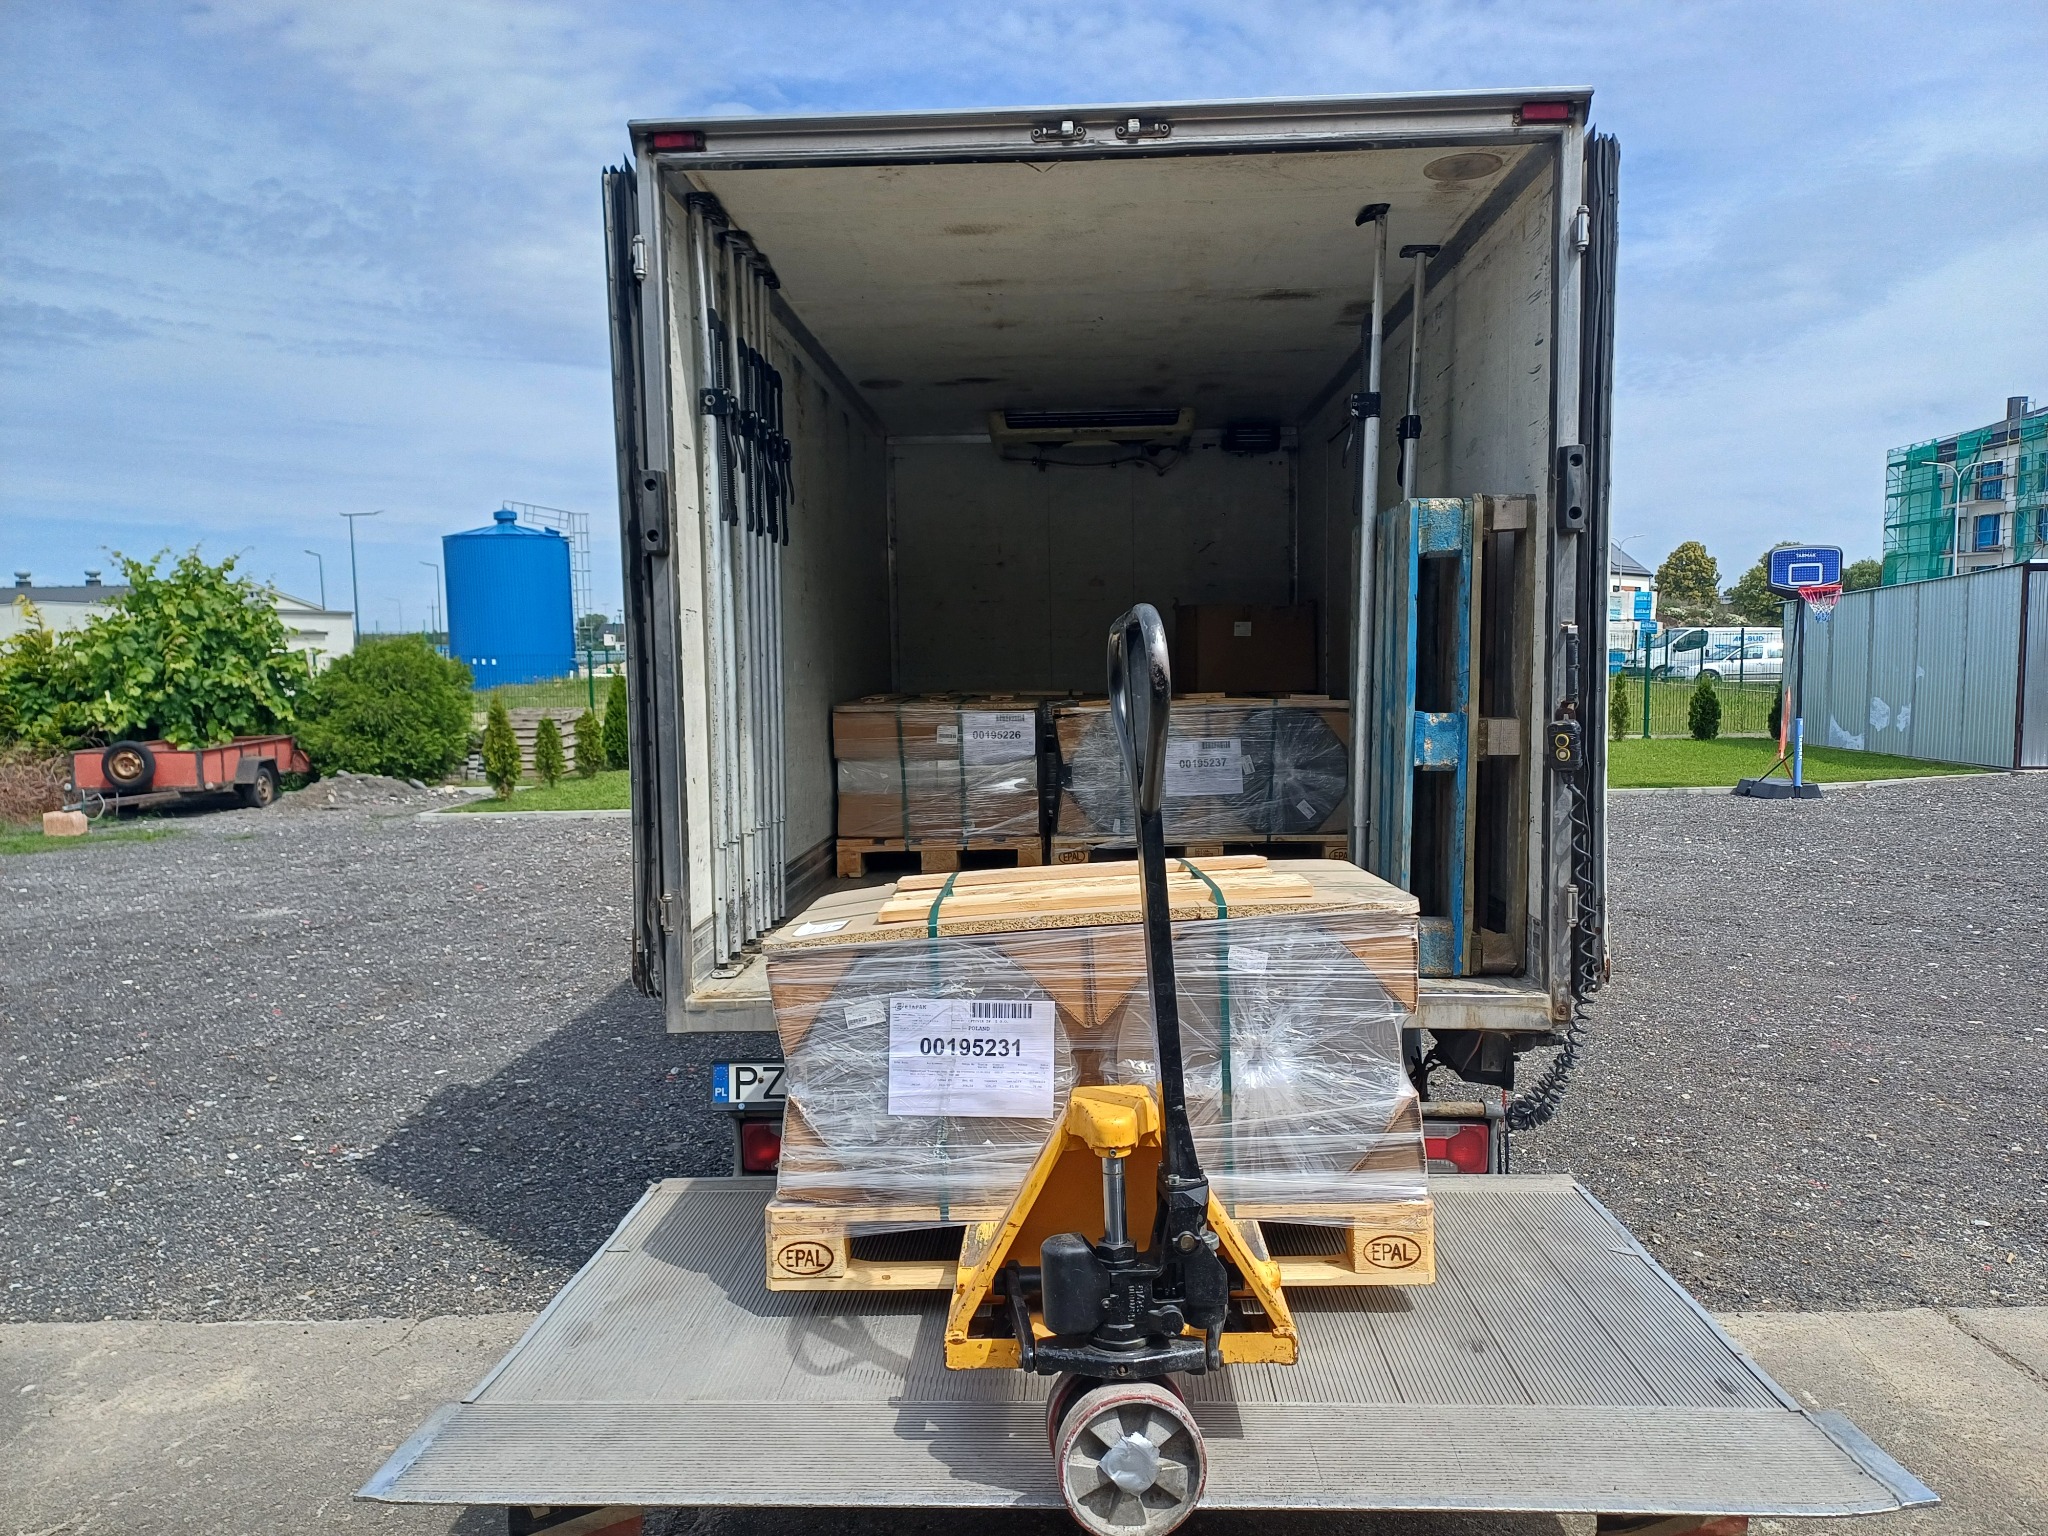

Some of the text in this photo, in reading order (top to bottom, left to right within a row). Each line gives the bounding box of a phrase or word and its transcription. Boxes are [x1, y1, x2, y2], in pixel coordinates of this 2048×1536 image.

[972, 731, 1021, 739] 00195226
[1179, 758, 1227, 768] 00195237
[1063, 851, 1082, 861] EPAL
[920, 1037, 1021, 1057] 00195231
[714, 1088, 727, 1097] PL
[1372, 1243, 1413, 1261] EPAL
[786, 1249, 825, 1267] EPAL
